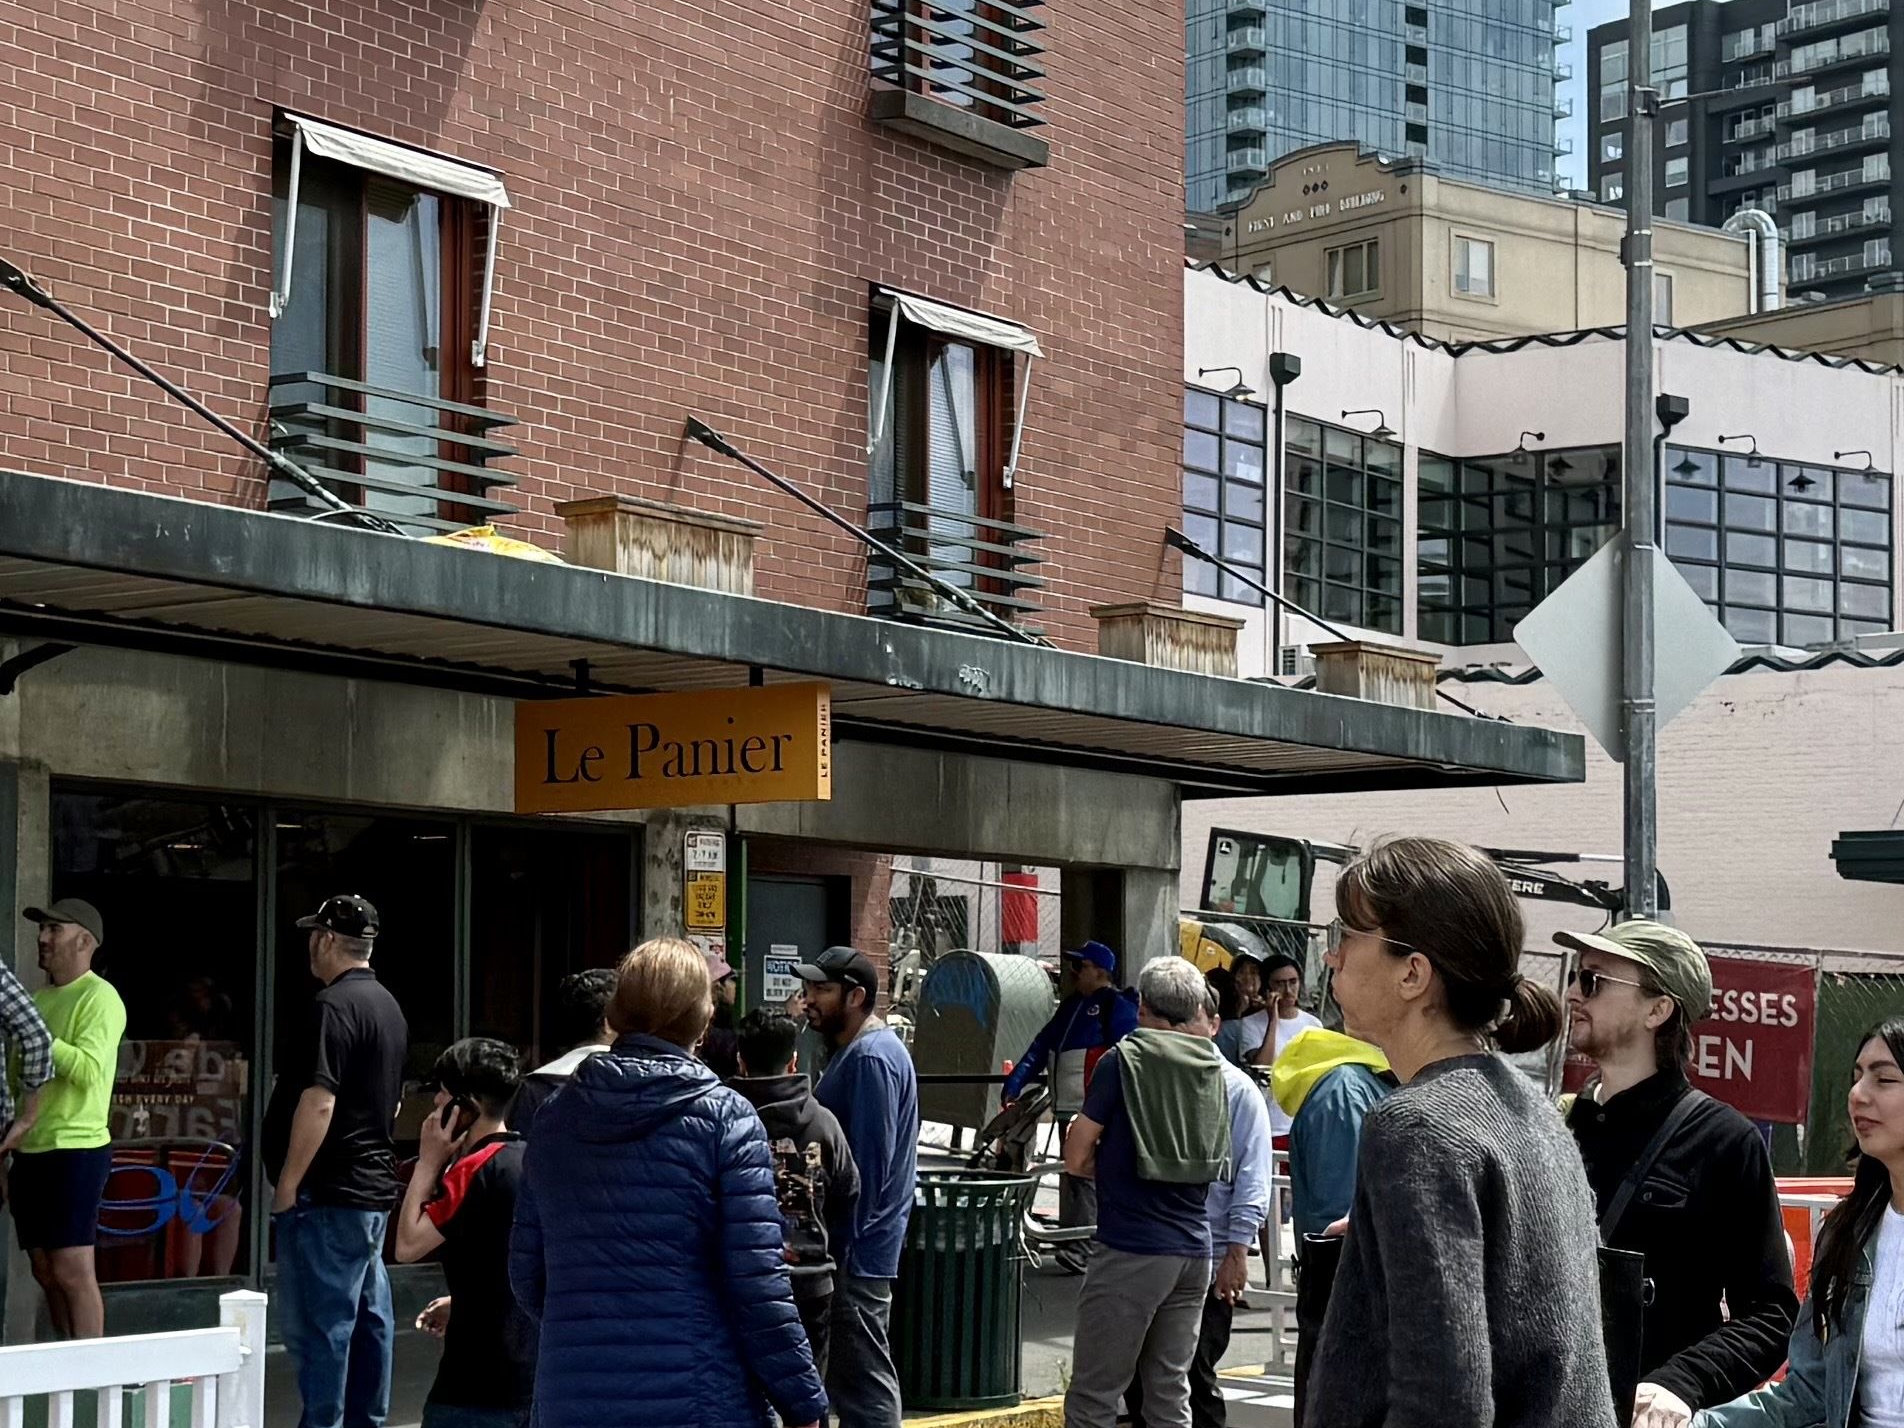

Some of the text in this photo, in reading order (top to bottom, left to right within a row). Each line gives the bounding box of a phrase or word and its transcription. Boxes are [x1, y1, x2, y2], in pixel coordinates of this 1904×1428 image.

[1282, 209, 1304, 225] AND
[543, 716, 793, 784] Le Panier
[820, 703, 830, 778] LE PANIER
[1505, 878, 1544, 895] ERE
[1709, 988, 1799, 1028] ESSES
[1696, 1035, 1754, 1082] EN
